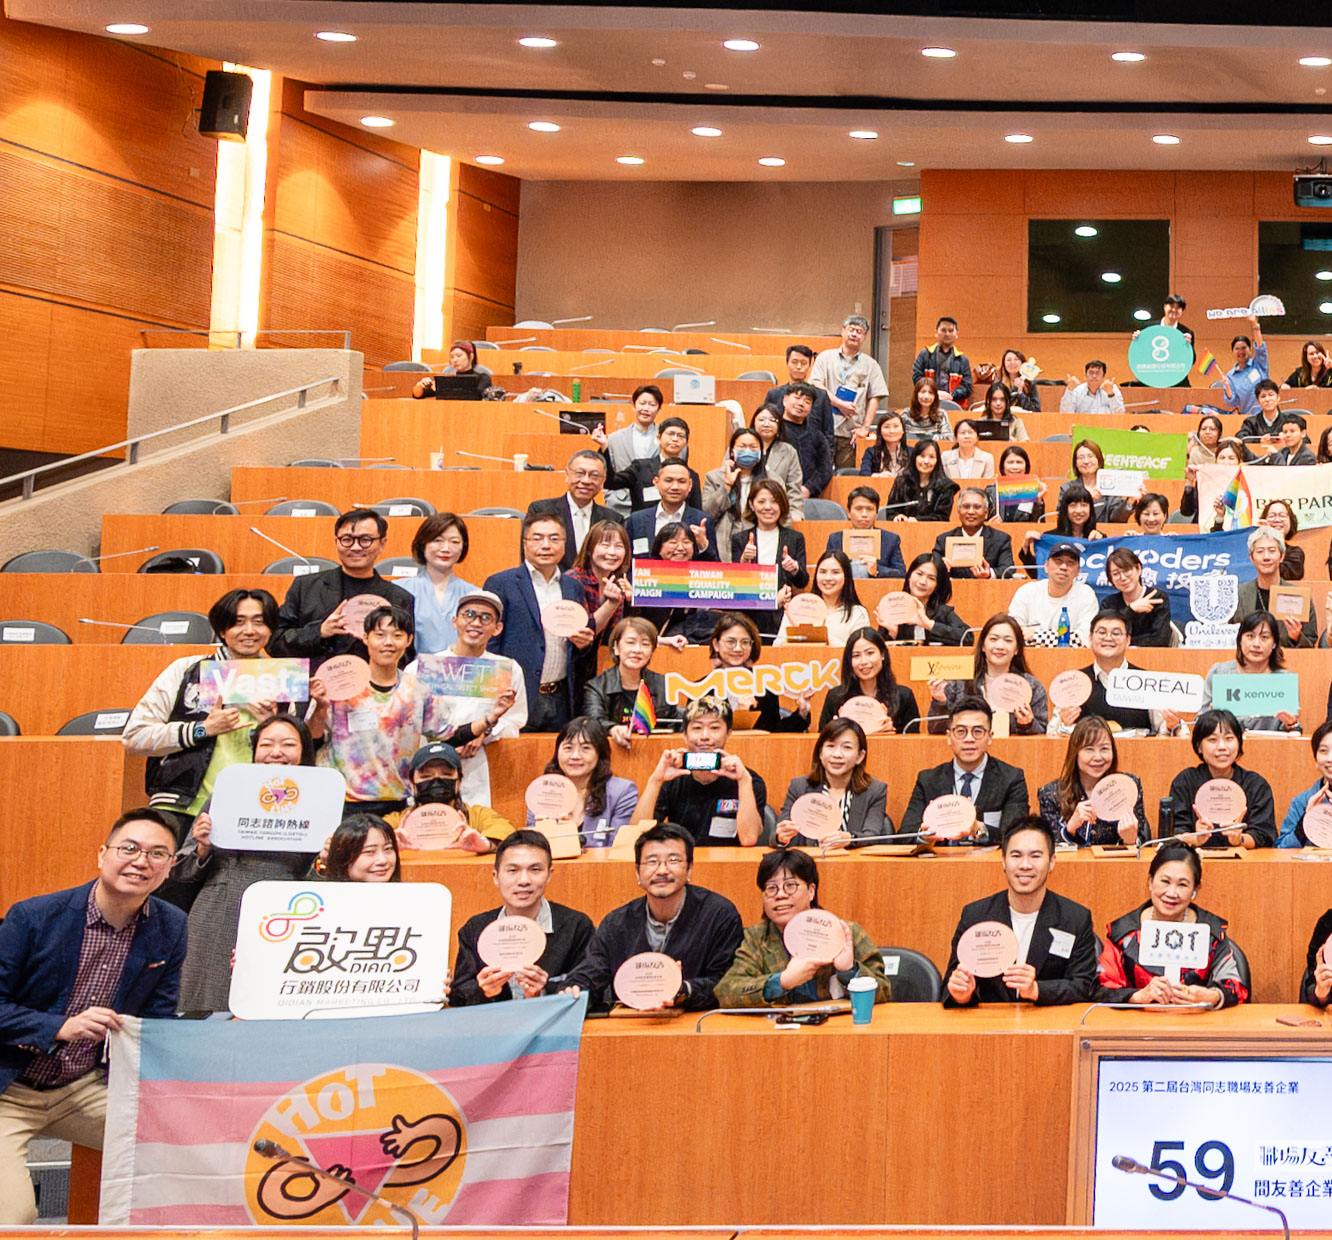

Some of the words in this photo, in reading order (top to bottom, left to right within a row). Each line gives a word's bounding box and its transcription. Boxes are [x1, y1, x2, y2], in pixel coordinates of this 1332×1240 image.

[1103, 453, 1172, 470] EENPEACE
[1073, 542, 1231, 571] coders
[689, 570, 723, 580] TAIWAN
[689, 580, 730, 590] EQUALITY
[689, 590, 734, 600] CAMPAIGN
[440, 663, 493, 684] WET
[237, 817, 310, 829] 同志諮詢熱線
[1151, 928, 1199, 951] JOT
[280, 978, 421, 995] 行銷股份有限公司
[1109, 1081, 1139, 1092] 2025
[1142, 1080, 1299, 1094] 第二屆台灣同志職場友善企業
[264, 1064, 387, 1138] HOT
[1148, 1140, 1235, 1201] 59
